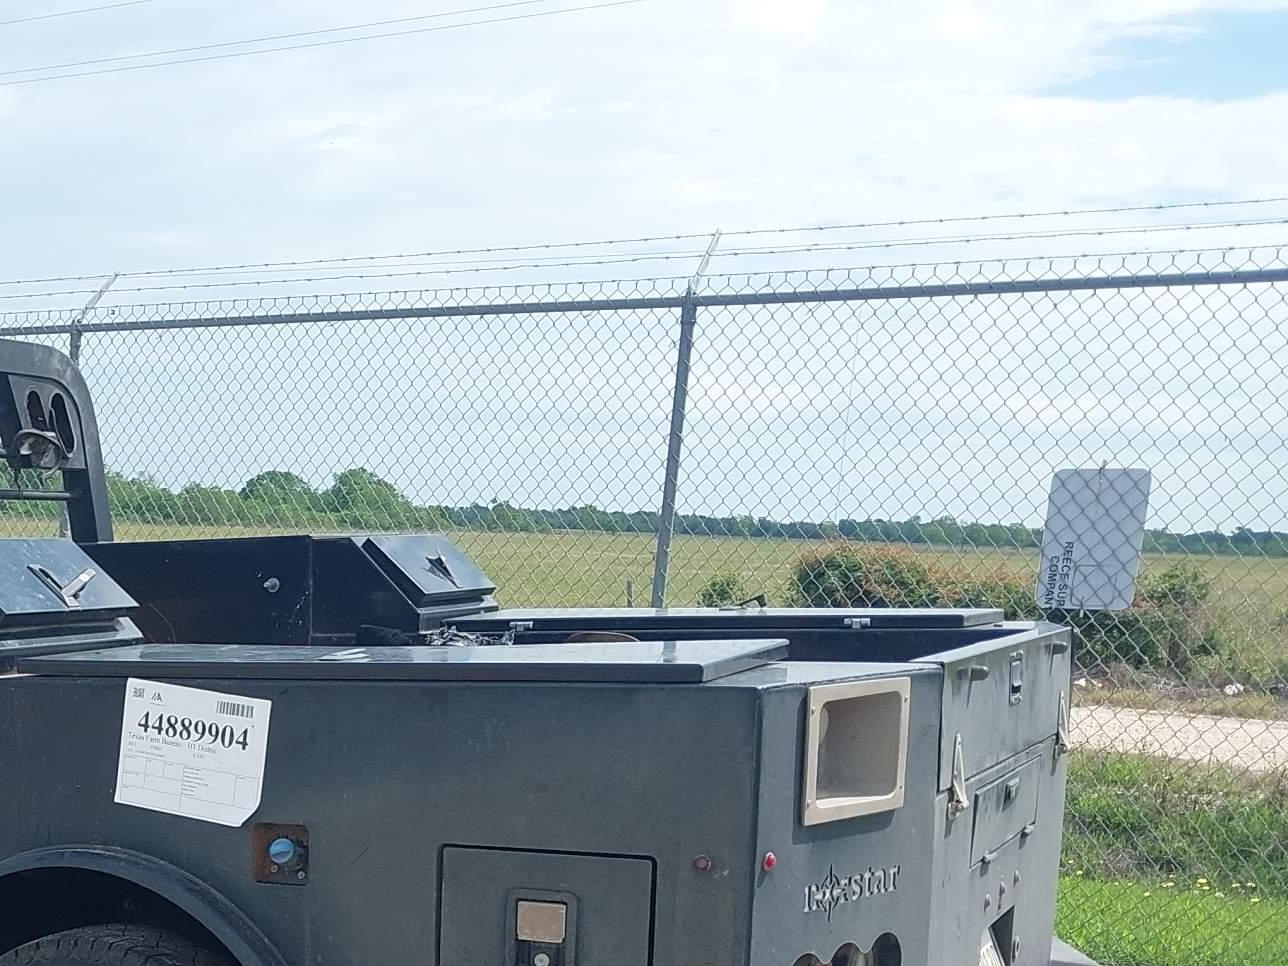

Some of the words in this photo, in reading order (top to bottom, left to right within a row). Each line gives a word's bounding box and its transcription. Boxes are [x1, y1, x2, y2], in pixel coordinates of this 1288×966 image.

[1060, 541, 1074, 582] REECE
[128, 732, 145, 742] Texas
[145, 736, 161, 744] Farm
[137, 710, 249, 751] 44889904
